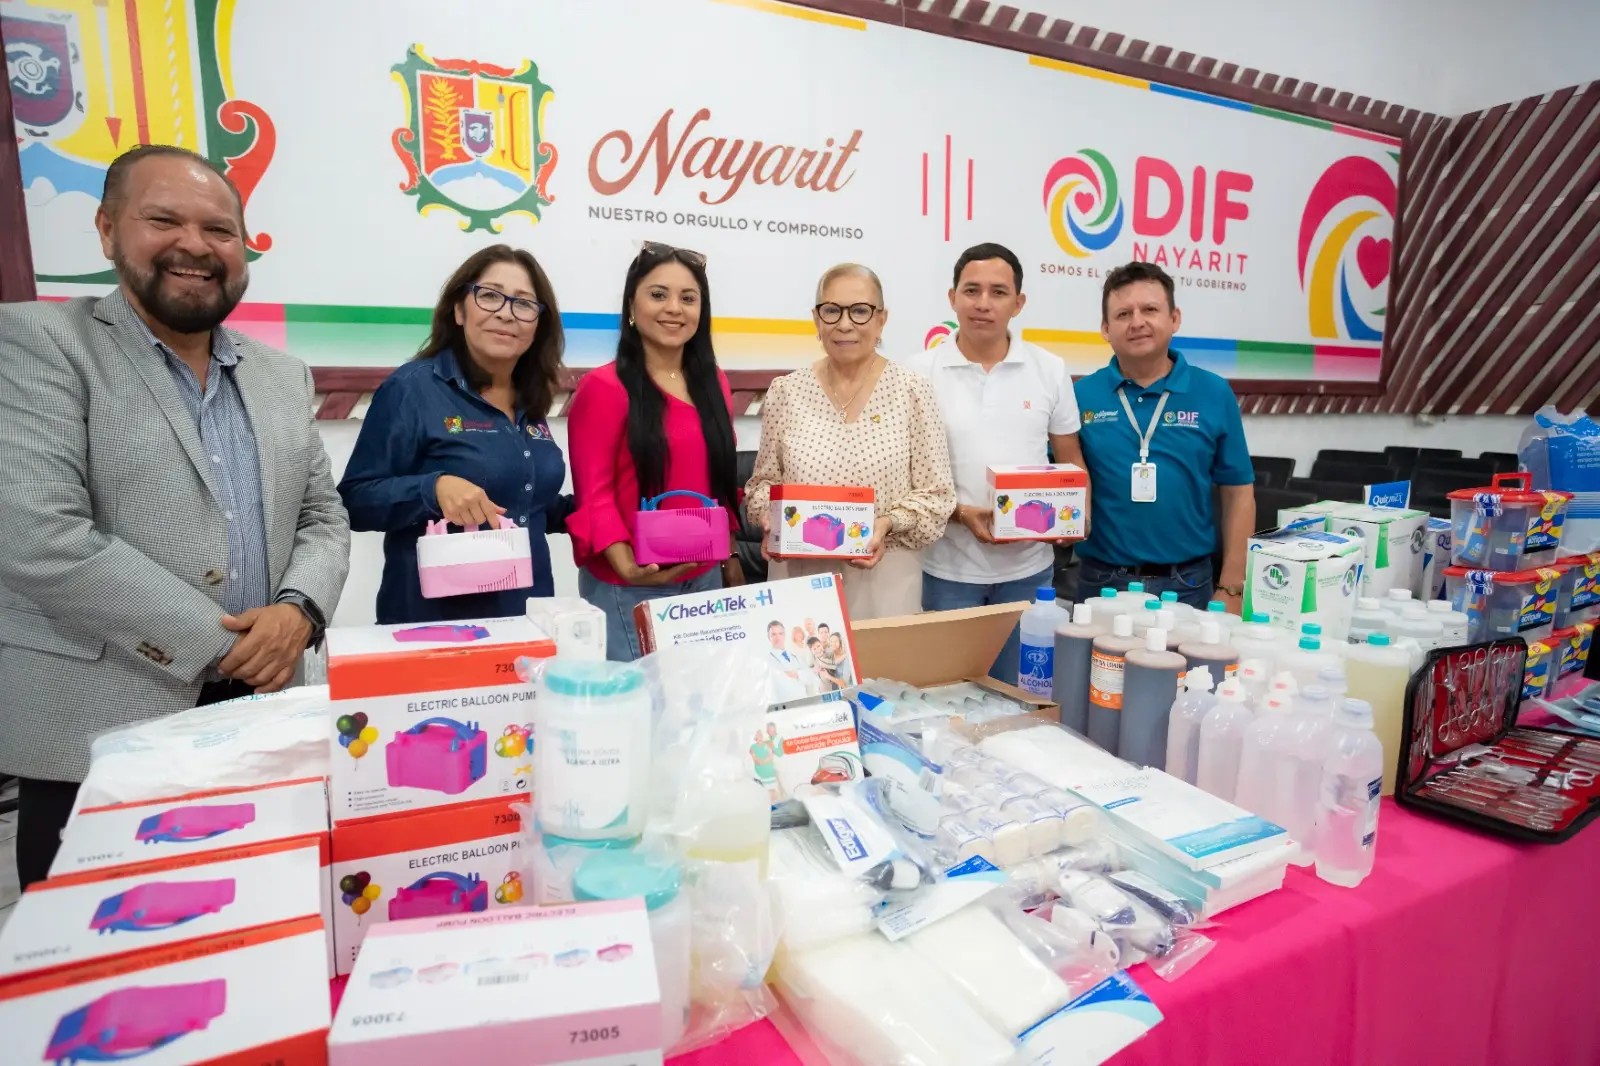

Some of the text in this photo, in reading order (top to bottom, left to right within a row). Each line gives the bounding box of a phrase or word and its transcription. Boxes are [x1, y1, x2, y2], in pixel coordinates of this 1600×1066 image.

[588, 107, 863, 205] Nayarit
[1132, 155, 1254, 245] DIF
[588, 205, 864, 240] NUESTRO ORGULLO Y COMPROMISO
[1132, 241, 1248, 275] NAYARIT
[1040, 263, 1083, 277] SOMOS
[1087, 267, 1100, 278] EL
[1180, 276, 1193, 287] TU
[1196, 278, 1247, 291] GOBIERNO
[1177, 410, 1200, 421] DIF
[668, 594, 747, 621] CheckATek
[724, 630, 746, 642] Eco
[494, 662, 515, 674] 730
[1020, 675, 1054, 689] ALCOHOL
[407, 697, 459, 713] ELECTRIC
[461, 692, 510, 708] BALLOON
[494, 812, 521, 825] 7300
[408, 851, 460, 869] ELECTRIC
[461, 843, 509, 860] BALLOON
[436, 907, 576, 928] ELECTRIC BALLOON PUMP
[351, 1010, 405, 1027] 73005
[569, 1025, 620, 1045] 73005
